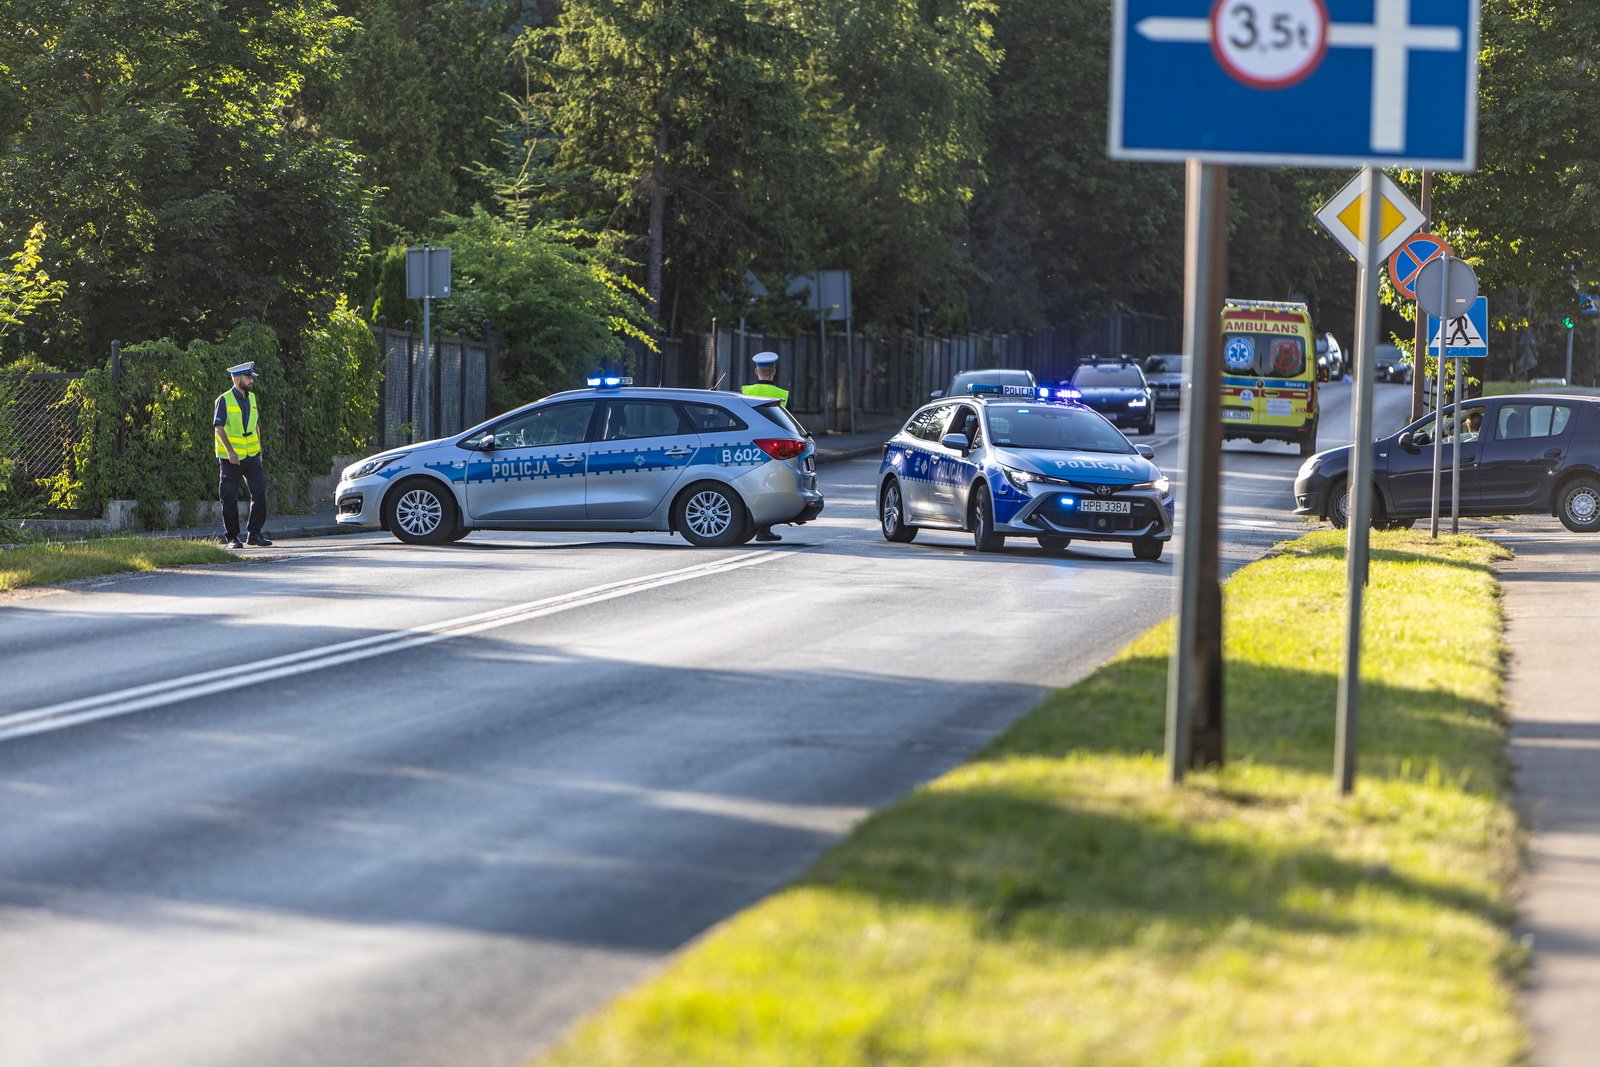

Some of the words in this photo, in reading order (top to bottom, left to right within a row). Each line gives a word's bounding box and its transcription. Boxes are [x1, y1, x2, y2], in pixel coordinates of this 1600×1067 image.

[1225, 321, 1298, 334] AMBULANS
[1004, 386, 1034, 397] POLICJA
[722, 449, 732, 463] B
[734, 448, 762, 462] 602
[491, 460, 551, 478] POLICJA
[936, 460, 963, 482] POLICJA
[1053, 460, 1135, 473] POLICJA
[1082, 500, 1102, 511] HPB
[1104, 501, 1129, 513] 33BA
